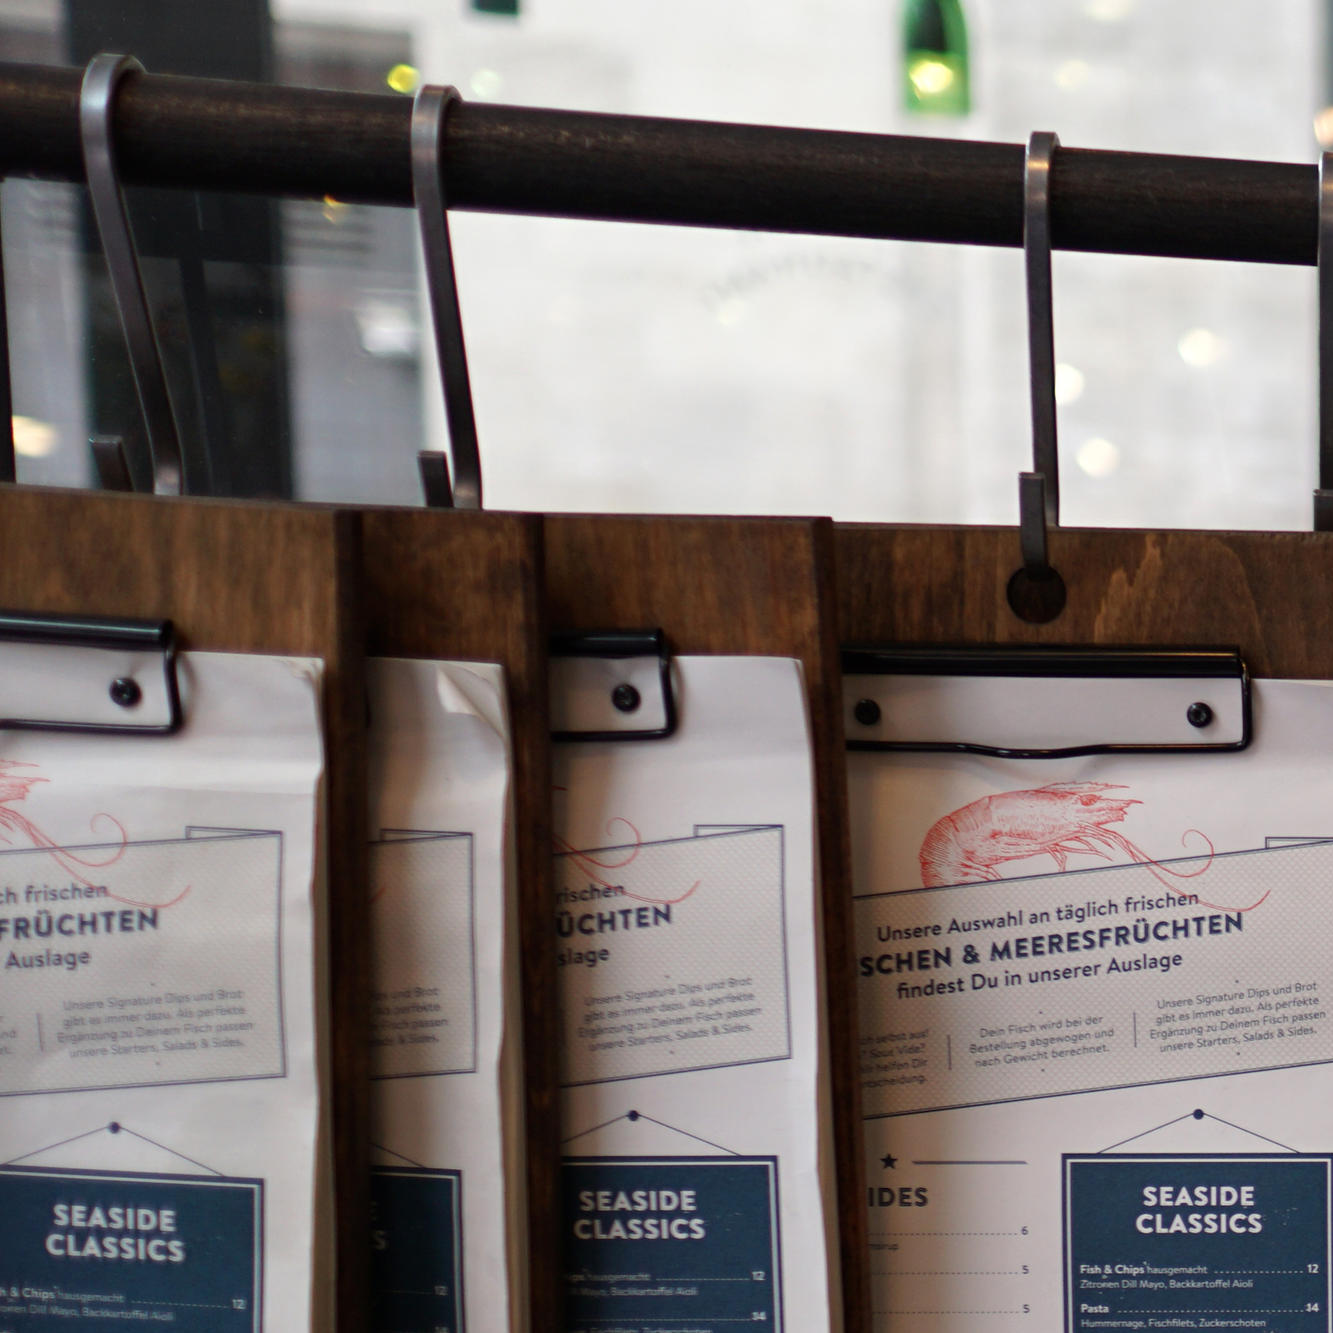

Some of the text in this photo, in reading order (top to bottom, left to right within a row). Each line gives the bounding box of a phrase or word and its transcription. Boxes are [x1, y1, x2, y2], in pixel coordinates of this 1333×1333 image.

[25, 884, 107, 903] frischen
[556, 903, 672, 938] ÜCHTEN
[877, 892, 1199, 942] Unsere Auswahl an täglich frischen
[963, 944, 980, 964] &
[990, 912, 1242, 962] MEERESFRÜCHTEN
[5, 949, 91, 971] Auslage
[897, 953, 1183, 999] findest Du in unserer Auslage
[1157, 982, 1317, 1010] Unsere Signature Dips und Brot
[1155, 1014, 1176, 1027] gibt
[1178, 1014, 1190, 1022] es
[1192, 1008, 1225, 1020] immer
[1257, 1001, 1273, 1012] Als
[1275, 996, 1320, 1012] perfekte
[979, 1014, 1104, 1039] Dein Fisch wird bei der
[1150, 1011, 1327, 1041] Ergänzung zu Deinem Fisch passen
[970, 1027, 1115, 1055] Bestellung abgewogen und
[1160, 1026, 1317, 1053] unsere Starters, Salads & Sides.
[975, 1056, 1001, 1068] nach
[1004, 1050, 1049, 1066] Gewicht
[579, 1190, 696, 1212] SEASIDE
[868, 1187, 929, 1208] IDES
[1143, 1186, 1255, 1206] SEASIDE
[53, 1203, 176, 1232] SEASIDE
[1136, 1213, 1262, 1234] CLASSICS
[573, 1219, 705, 1240] CLASSICS
[1021, 1226, 1028, 1236] 6
[45, 1234, 186, 1263] CLASSICS
[1022, 1265, 1029, 1274] 5
[1080, 1264, 1319, 1277] Fish & Chips hausgemacht 12
[1080, 1278, 1253, 1291] Zitronen Dill Mayo, Backkartoffel Aioli
[232, 1299, 246, 1310] 12
[1022, 1304, 1030, 1314] 5
[1080, 1304, 1109, 1314] Pasta
[1149, 1318, 1197, 1329] Fischfilets,
[1199, 1317, 1266, 1328] Zuckerschoten
